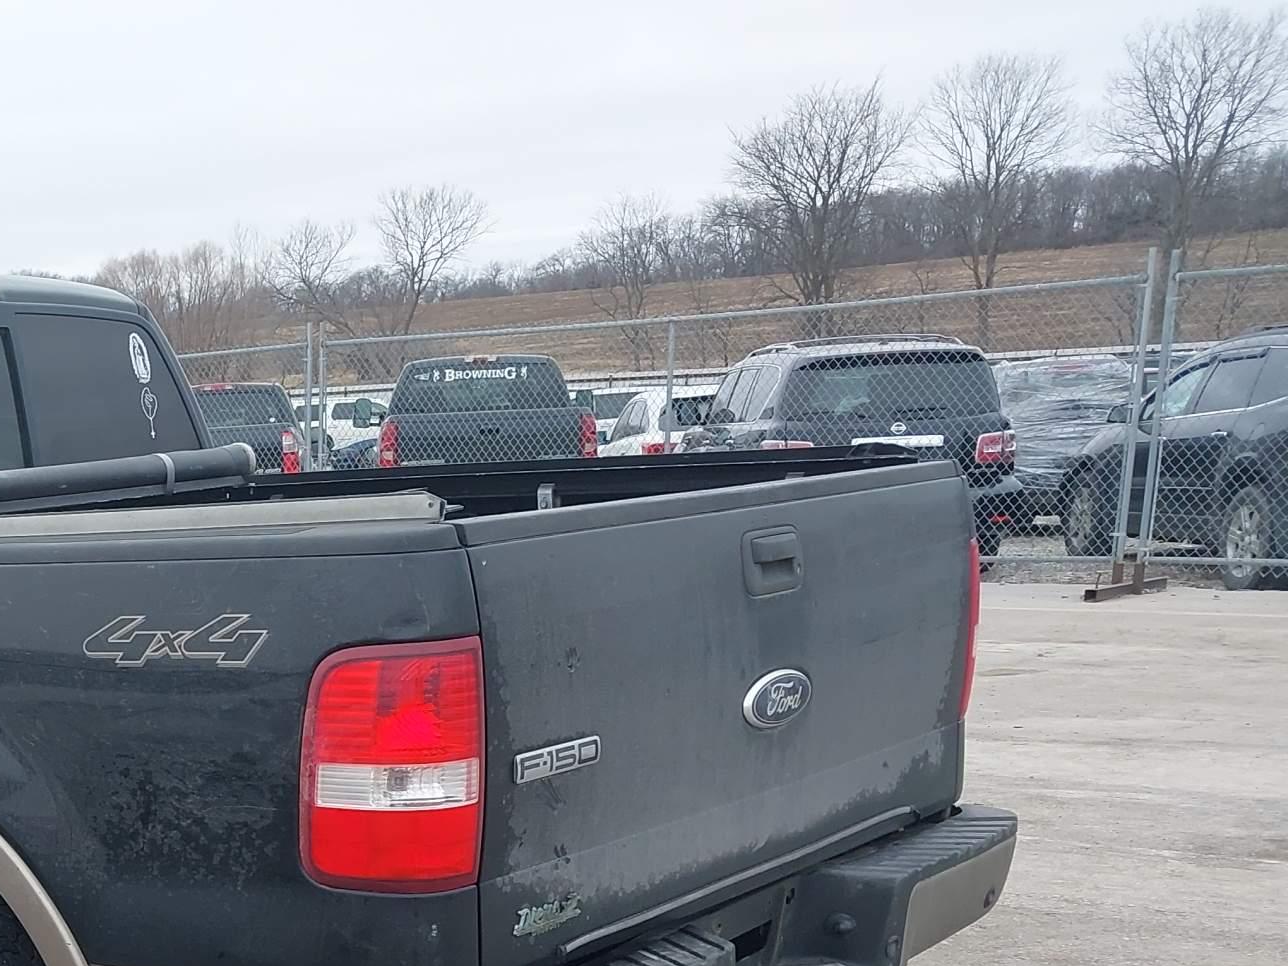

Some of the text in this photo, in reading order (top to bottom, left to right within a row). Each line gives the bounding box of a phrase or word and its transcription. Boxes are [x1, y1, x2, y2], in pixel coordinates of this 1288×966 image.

[444, 366, 517, 382] BROWNING
[83, 613, 270, 668] 4x4
[766, 680, 804, 717] Ford
